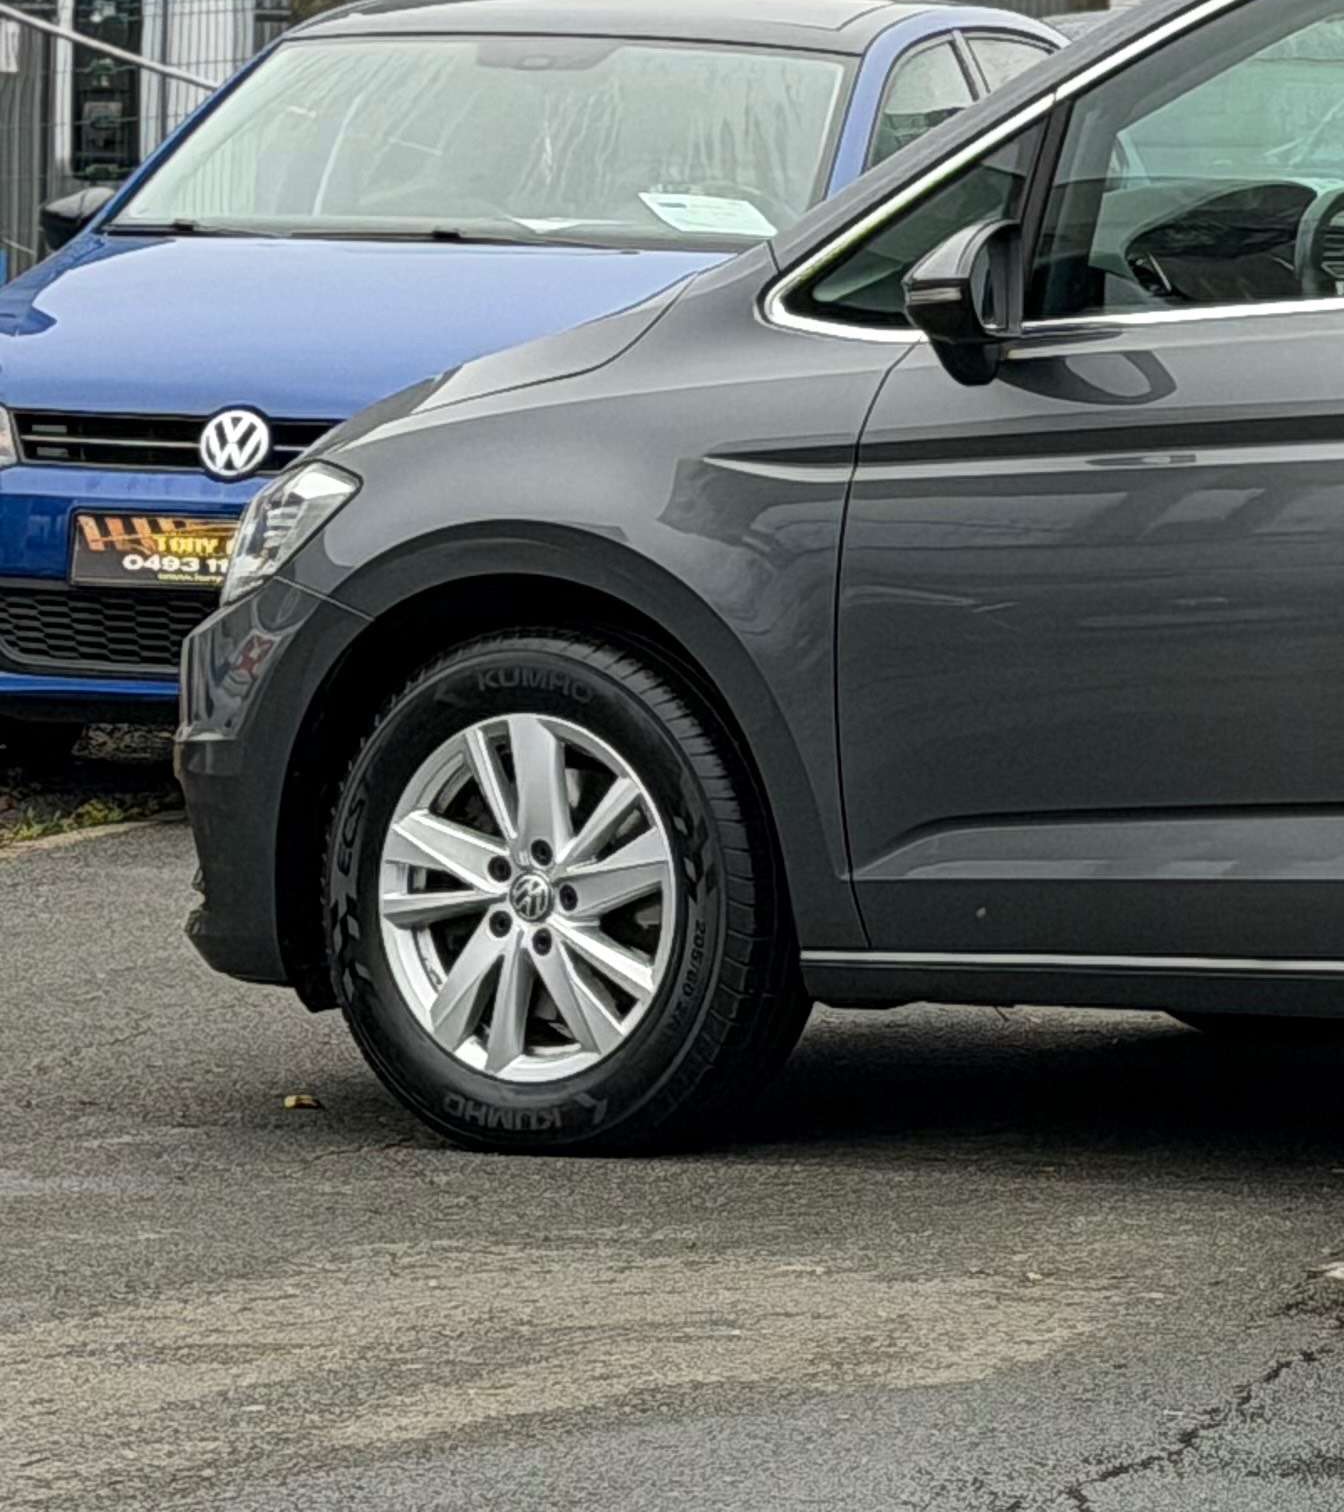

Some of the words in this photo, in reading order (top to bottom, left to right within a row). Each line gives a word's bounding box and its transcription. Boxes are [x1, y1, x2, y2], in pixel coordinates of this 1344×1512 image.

[122, 553, 200, 572] 0493
[477, 667, 593, 704] KUMHO
[442, 1092, 563, 1131] KUMHO
